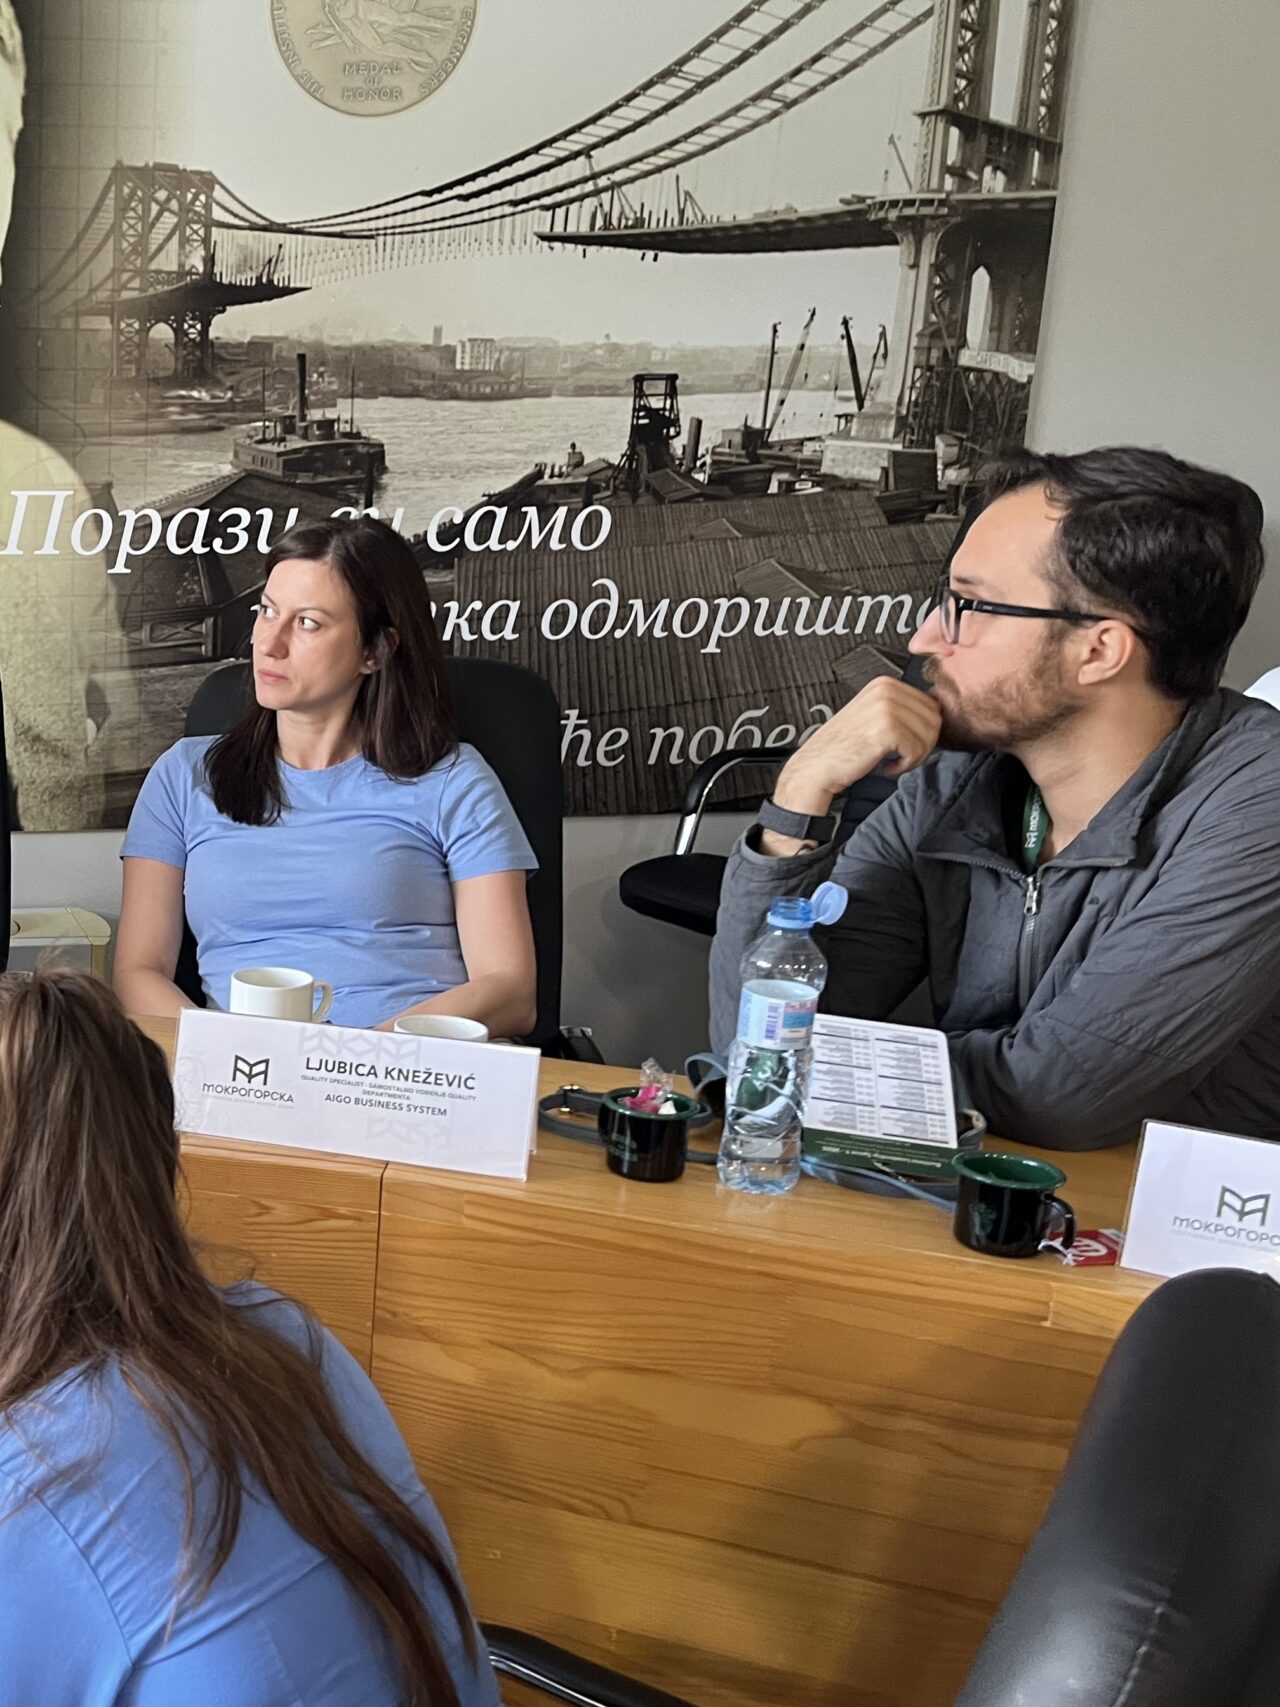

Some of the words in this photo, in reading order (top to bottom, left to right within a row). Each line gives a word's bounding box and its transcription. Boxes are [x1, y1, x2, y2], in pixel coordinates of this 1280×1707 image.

[344, 61, 401, 75] MEDAL
[343, 88, 401, 100] HONOR
[426, 503, 612, 553] само
[560, 709, 630, 768] ће
[305, 1056, 378, 1080] LJUBICA
[384, 1066, 477, 1091] KNEŽEVIĆ
[202, 1083, 295, 1103] МОКРОГОРСКА
[300, 1074, 329, 1084] QUALITY
[447, 1093, 477, 1102] QUALITY
[324, 1093, 352, 1105] AIGO
[354, 1098, 404, 1111] BUSINESS
[406, 1104, 448, 1117] SYSTEM
